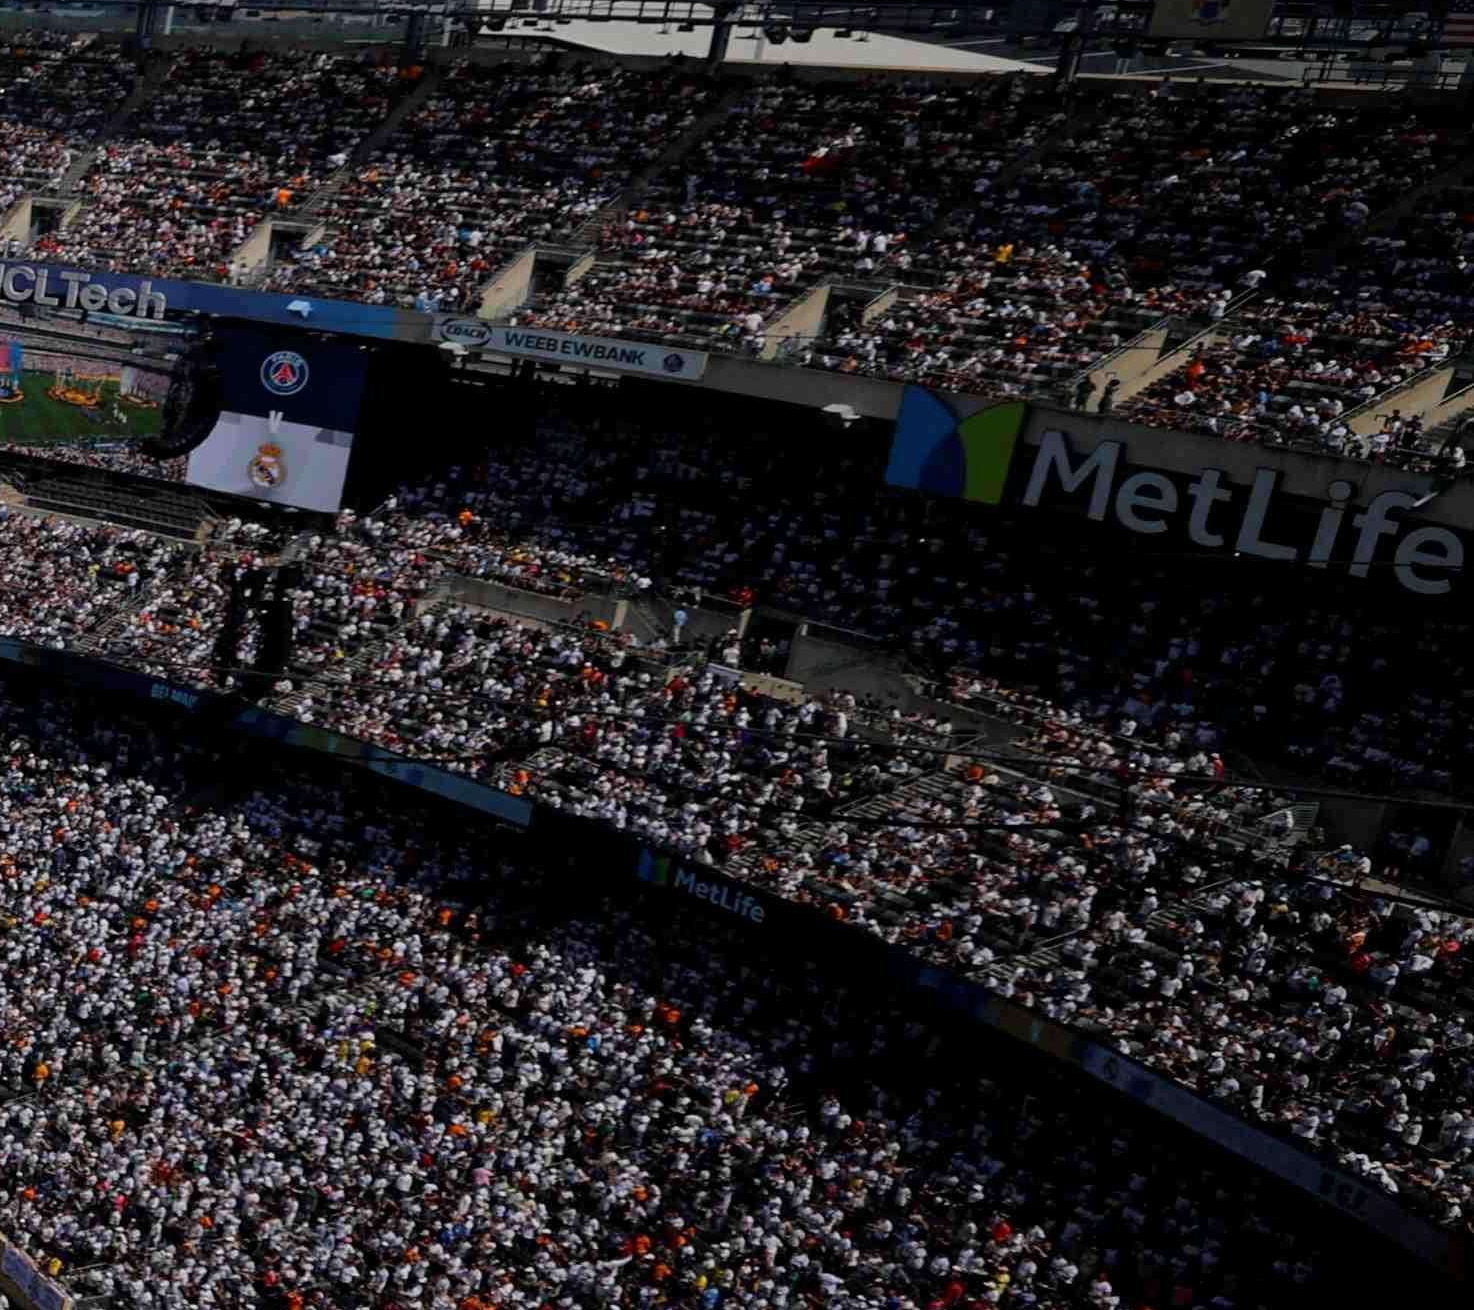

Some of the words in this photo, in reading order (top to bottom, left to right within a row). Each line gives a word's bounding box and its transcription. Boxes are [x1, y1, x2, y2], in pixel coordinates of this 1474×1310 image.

[445, 324, 487, 340] COACH
[505, 331, 558, 353] WEEB
[561, 340, 648, 366] EWBANK
[1021, 428, 1466, 596] MetLife
[673, 865, 768, 925] MetLife
